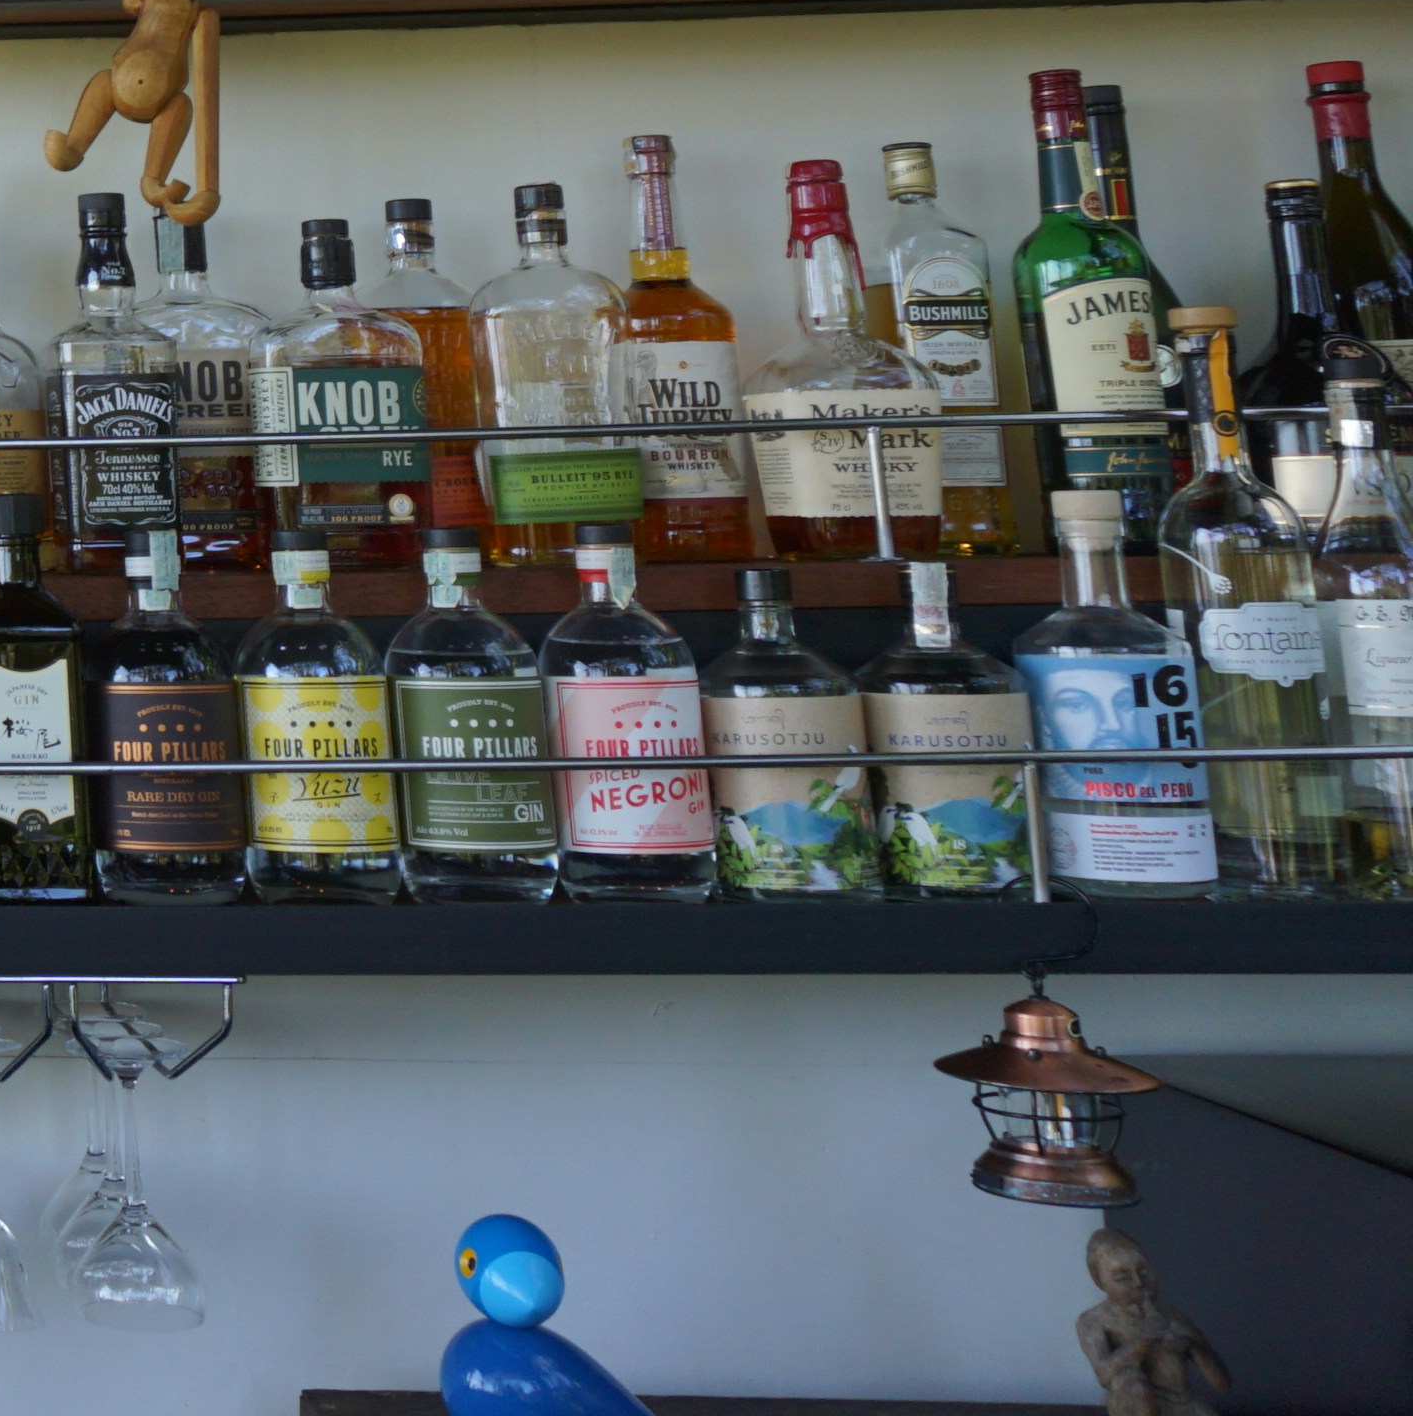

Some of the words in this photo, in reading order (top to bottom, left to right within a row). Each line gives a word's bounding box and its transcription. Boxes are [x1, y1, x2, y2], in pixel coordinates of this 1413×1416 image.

[910, 306, 989, 322] BUSHMILLS
[648, 378, 721, 408] WILD
[77, 397, 114, 425] JACK
[298, 380, 401, 426] KNOB
[95, 450, 161, 464] Tennessee
[382, 450, 413, 467] RYE
[651, 448, 729, 462] BOURBON
[667, 461, 717, 471] WHISKEY
[96, 471, 161, 483] WHISKEY
[530, 471, 588, 485] BULLEIT
[1132, 665, 1189, 708] 16
[14, 694, 40, 705] GIN
[422, 736, 465, 758] FOUR
[473, 736, 538, 759] PILLARS
[888, 734, 1008, 748] KARUSOTJU
[589, 768, 640, 784] SPICED
[127, 791, 165, 802] RARE
[168, 791, 194, 803] DRY
[198, 791, 220, 802] GIN
[590, 773, 704, 813] NEGRONI
[1085, 780, 1136, 800] PISCO
[1161, 778, 1195, 799] PERÚ
[316, 801, 341, 809] GIN
[514, 804, 544, 822] GIN
